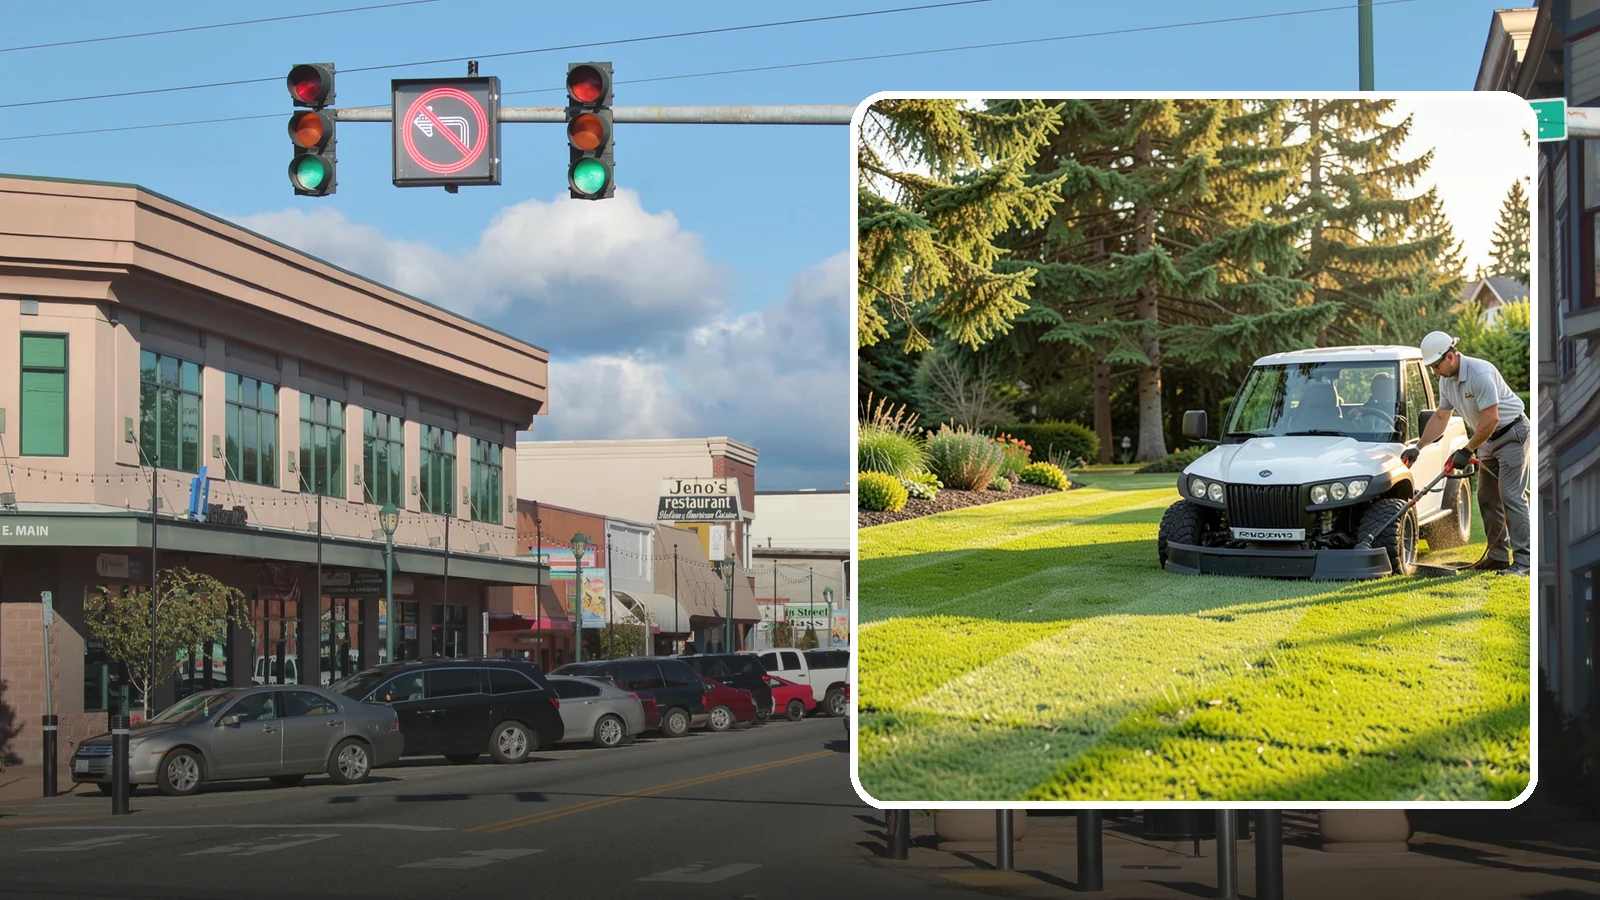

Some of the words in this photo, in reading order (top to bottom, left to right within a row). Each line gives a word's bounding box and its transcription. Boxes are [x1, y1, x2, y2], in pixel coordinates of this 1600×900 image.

[670, 480, 727, 494] Jeno's
[665, 496, 731, 509] restaurant
[686, 510, 714, 518] American
[715, 510, 737, 518] Cuisine
[2, 525, 13, 536] E.
[15, 525, 49, 536] MAIN
[797, 608, 828, 616] Street
